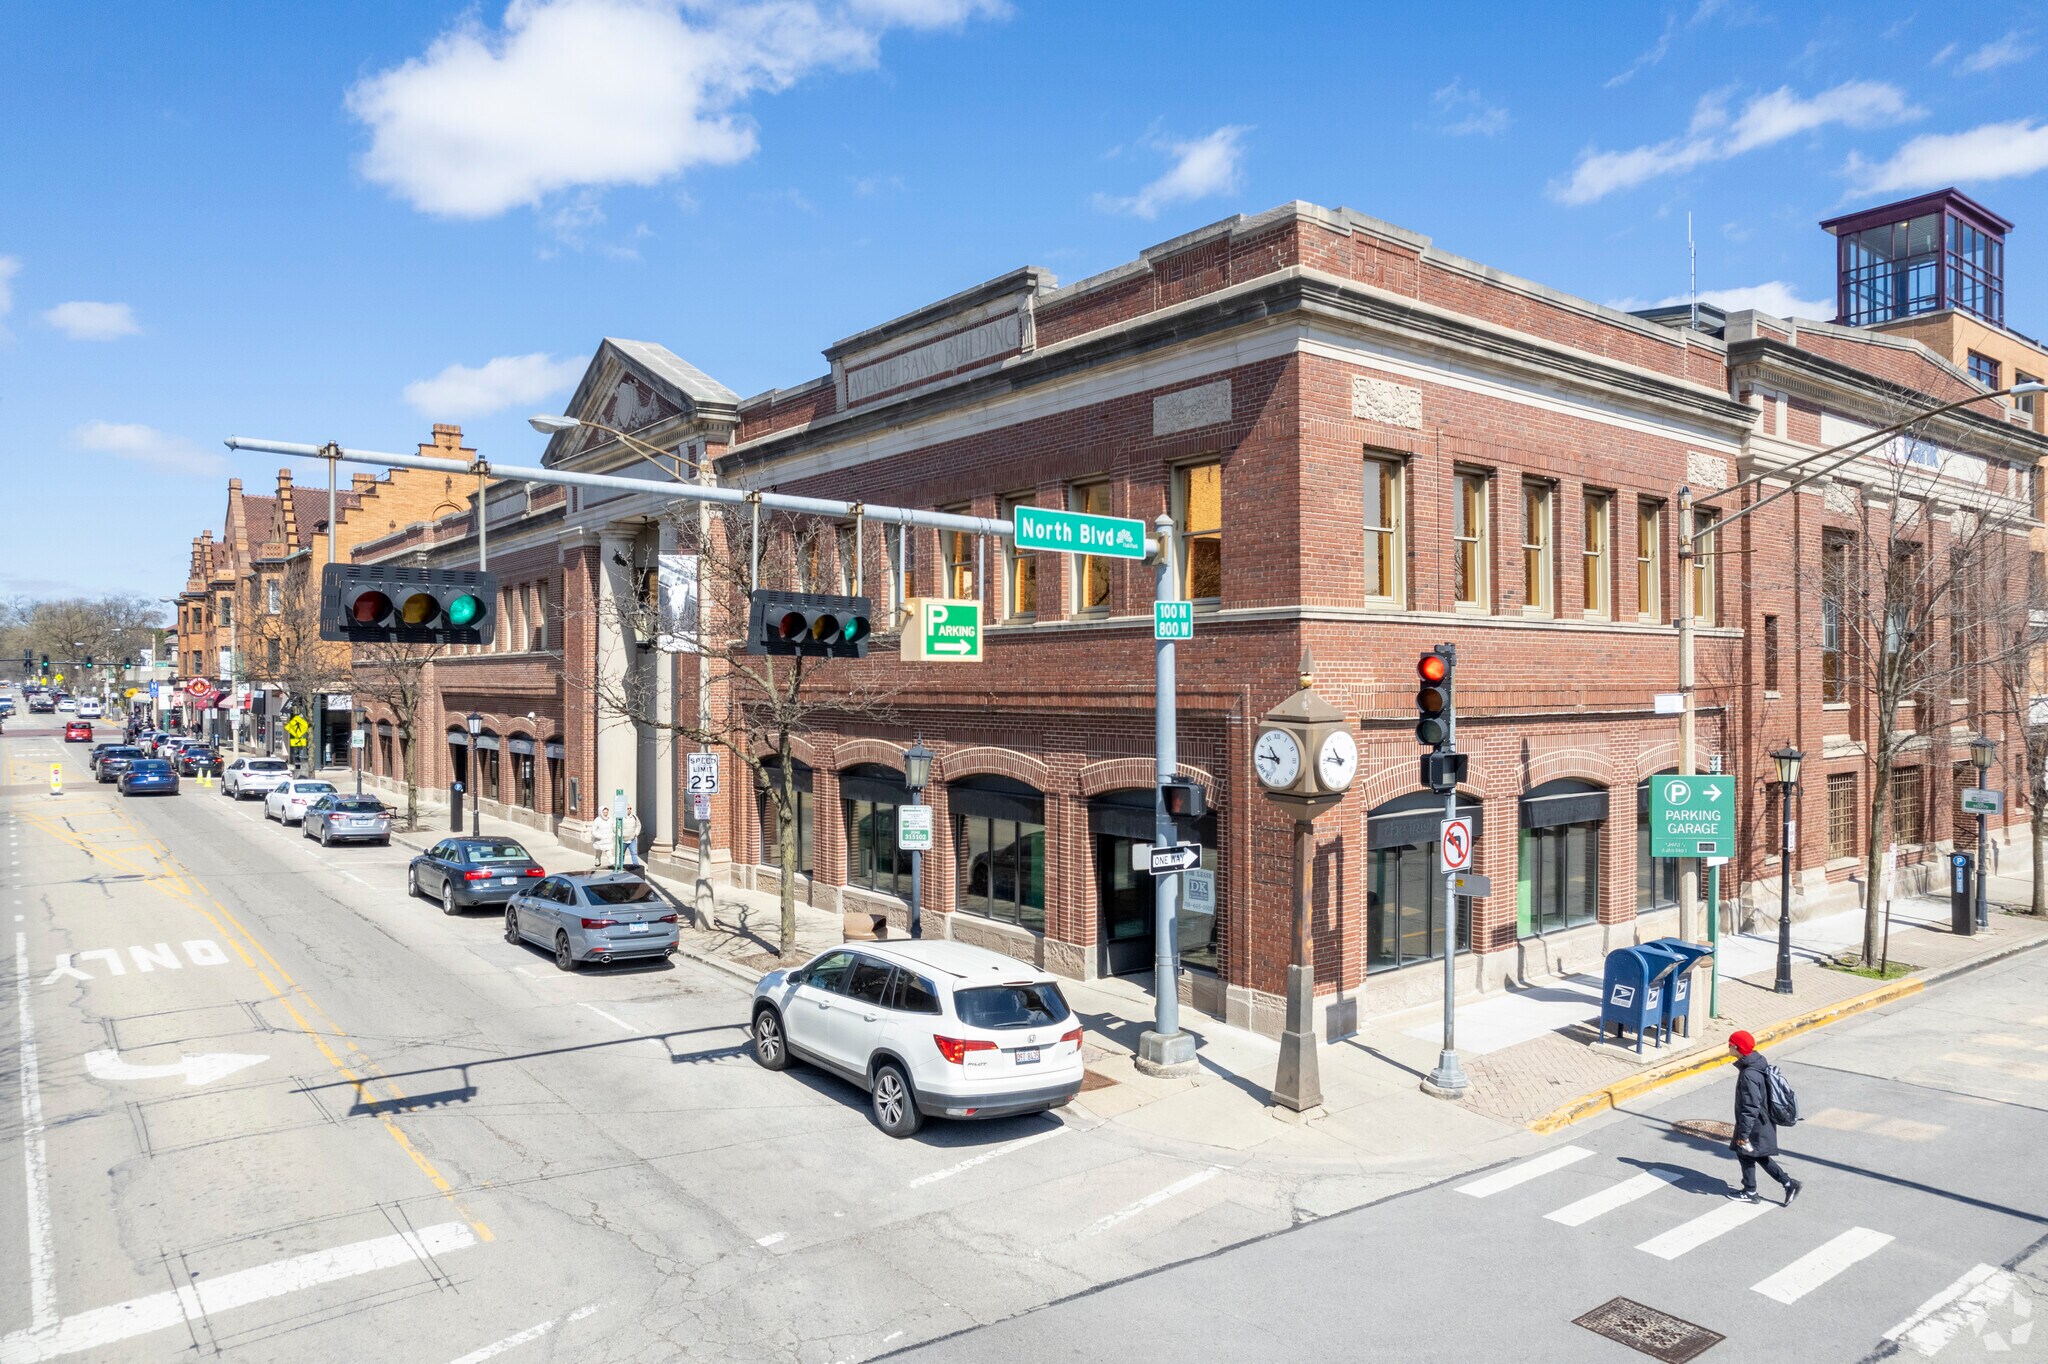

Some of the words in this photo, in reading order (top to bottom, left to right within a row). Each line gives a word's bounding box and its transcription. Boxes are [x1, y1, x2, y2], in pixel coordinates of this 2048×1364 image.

[850, 366, 897, 398] AVENUE
[902, 349, 939, 382] BANK
[945, 319, 1016, 369] BUILDING
[1022, 517, 1072, 542] North
[1080, 524, 1114, 546] Blvd
[1160, 604, 1177, 619] 100
[1179, 604, 1187, 619] N
[928, 605, 975, 637] PARKING
[1159, 621, 1179, 636] 800
[1181, 621, 1189, 636] W
[691, 776, 715, 789] 25
[1671, 784, 1687, 803] P
[1665, 810, 1721, 821] PARKING
[1667, 823, 1718, 834] GARAGE
[1154, 855, 1169, 866] ONE
[1170, 853, 1185, 863] WAY
[1190, 881, 1208, 893] DK
[39, 939, 230, 985] ONLY
